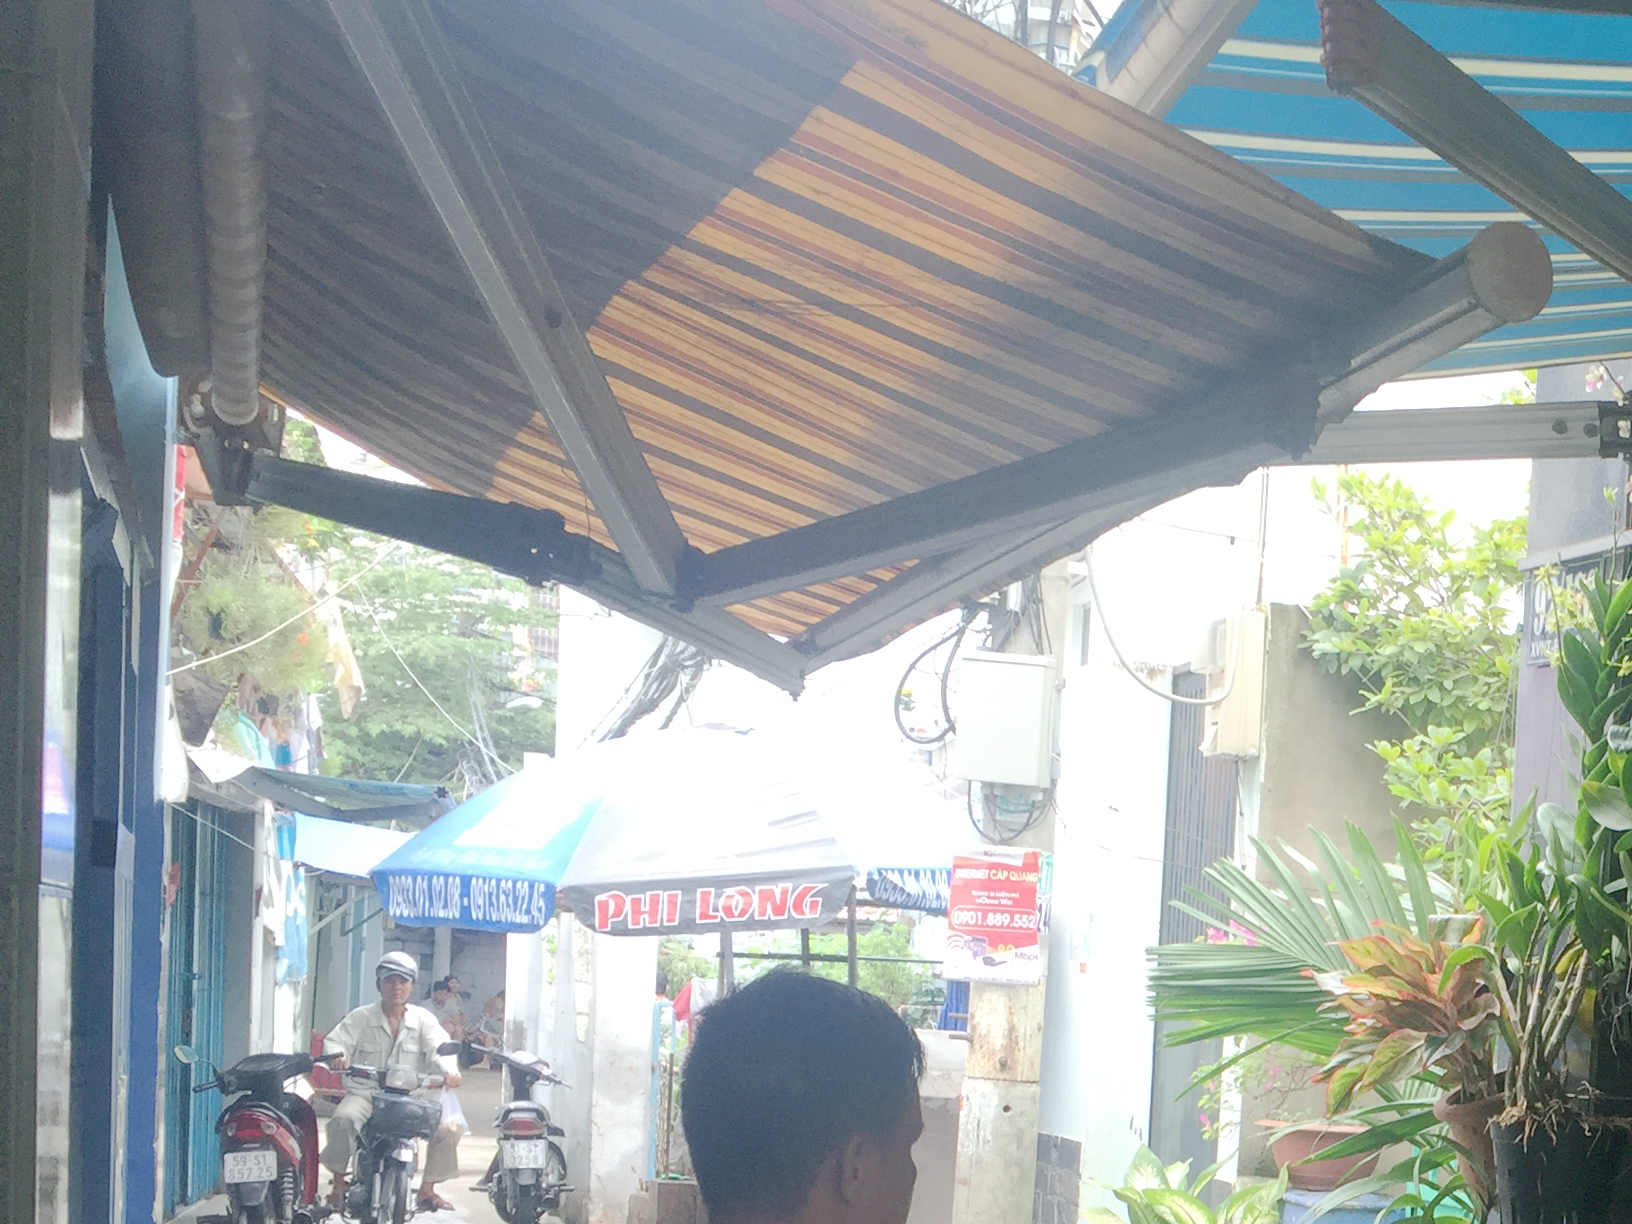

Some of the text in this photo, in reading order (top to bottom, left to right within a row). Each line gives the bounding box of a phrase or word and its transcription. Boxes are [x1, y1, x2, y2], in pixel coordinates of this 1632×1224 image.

[470, 877, 545, 926] 0913.63.22.45
[594, 883, 829, 931] PHI LONG
[953, 911, 1036, 928] 0901.889.552
[228, 1166, 273, 1181] 857.25
